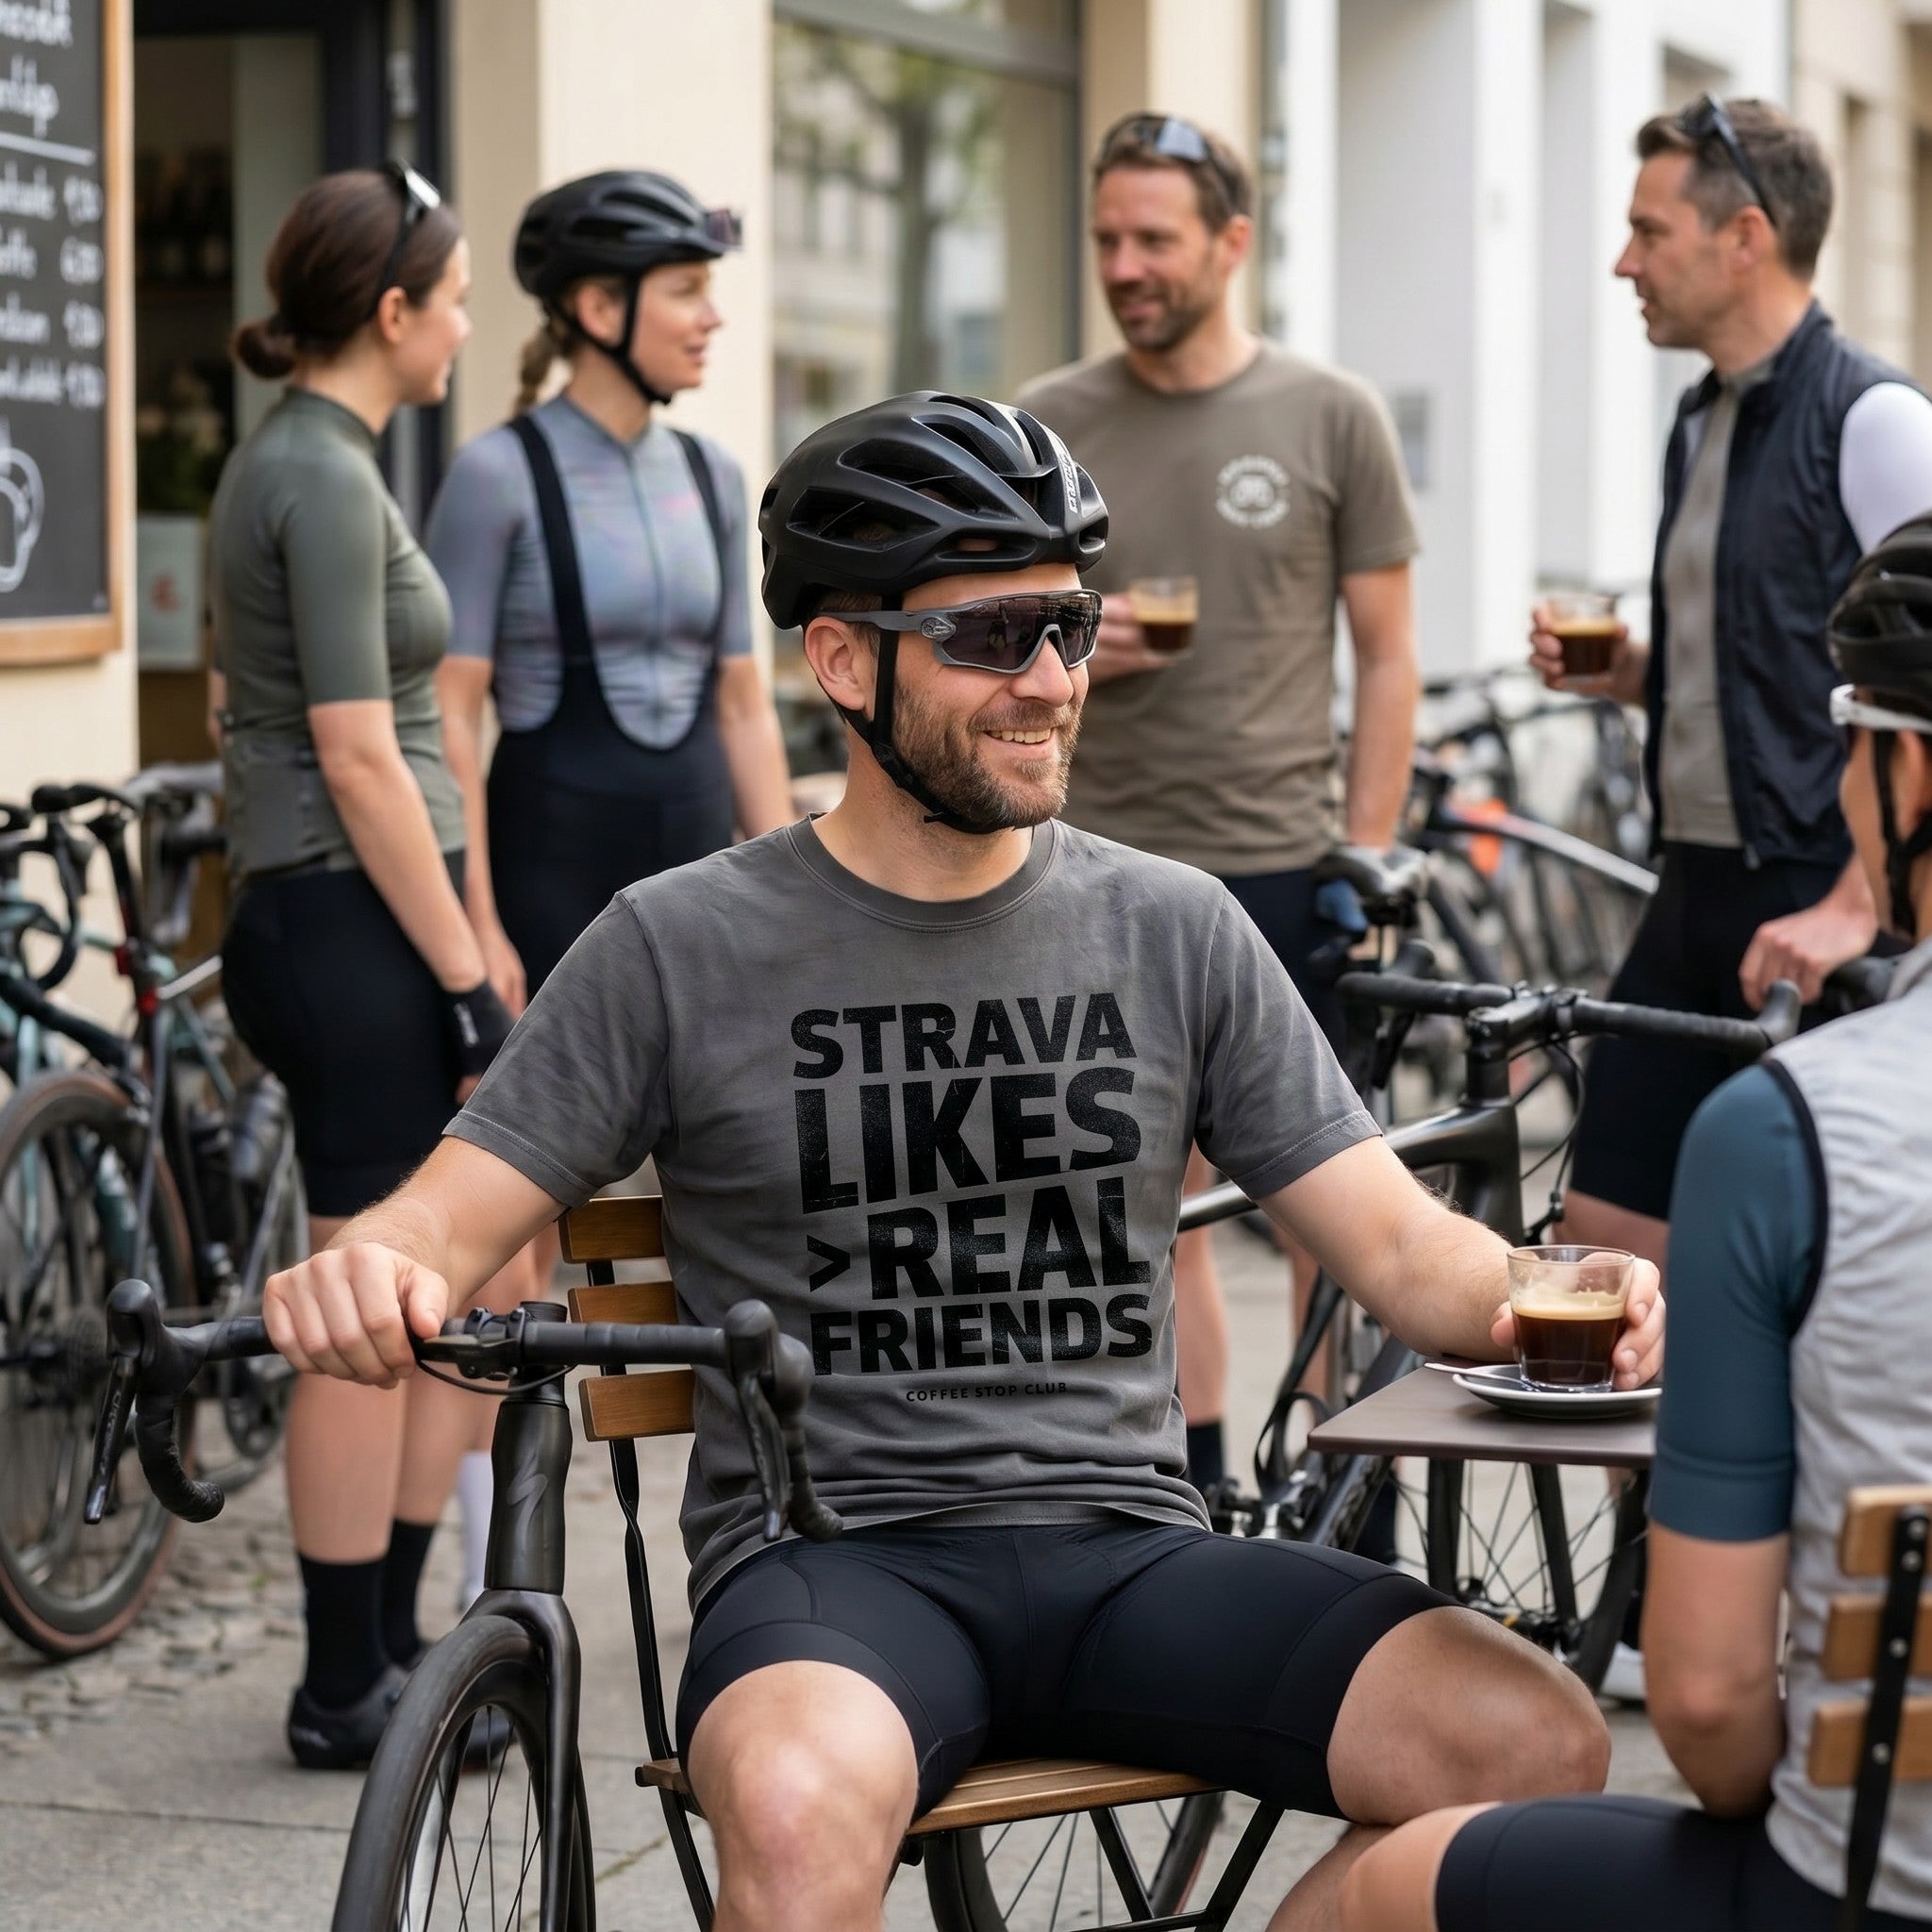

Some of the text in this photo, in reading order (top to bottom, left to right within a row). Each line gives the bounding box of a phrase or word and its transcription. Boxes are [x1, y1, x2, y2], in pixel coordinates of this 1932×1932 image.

[791, 992, 1137, 1079] STRAVA
[794, 1067, 1141, 1214] LIKES
[809, 1293, 1153, 1375] FRIENDS
[906, 1382, 1067, 1402] COFFEE STOP CLUB
